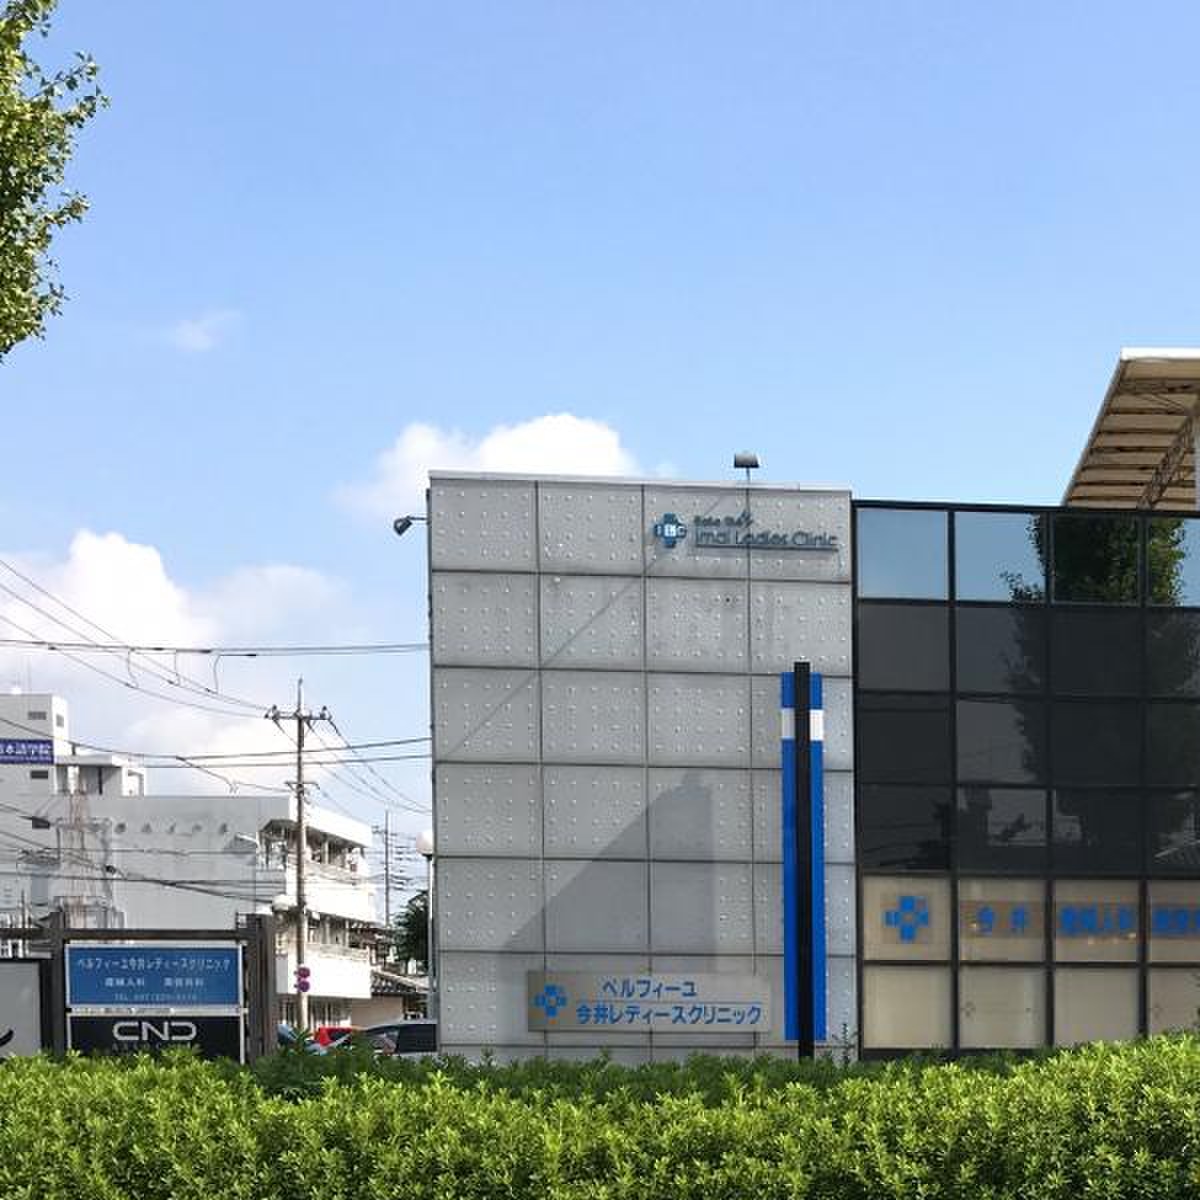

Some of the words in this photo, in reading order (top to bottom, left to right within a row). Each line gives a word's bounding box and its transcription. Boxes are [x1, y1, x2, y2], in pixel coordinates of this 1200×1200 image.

[602, 978, 697, 998] ベルフィーユ
[576, 1005, 762, 1025] 今井レディースクリニック
